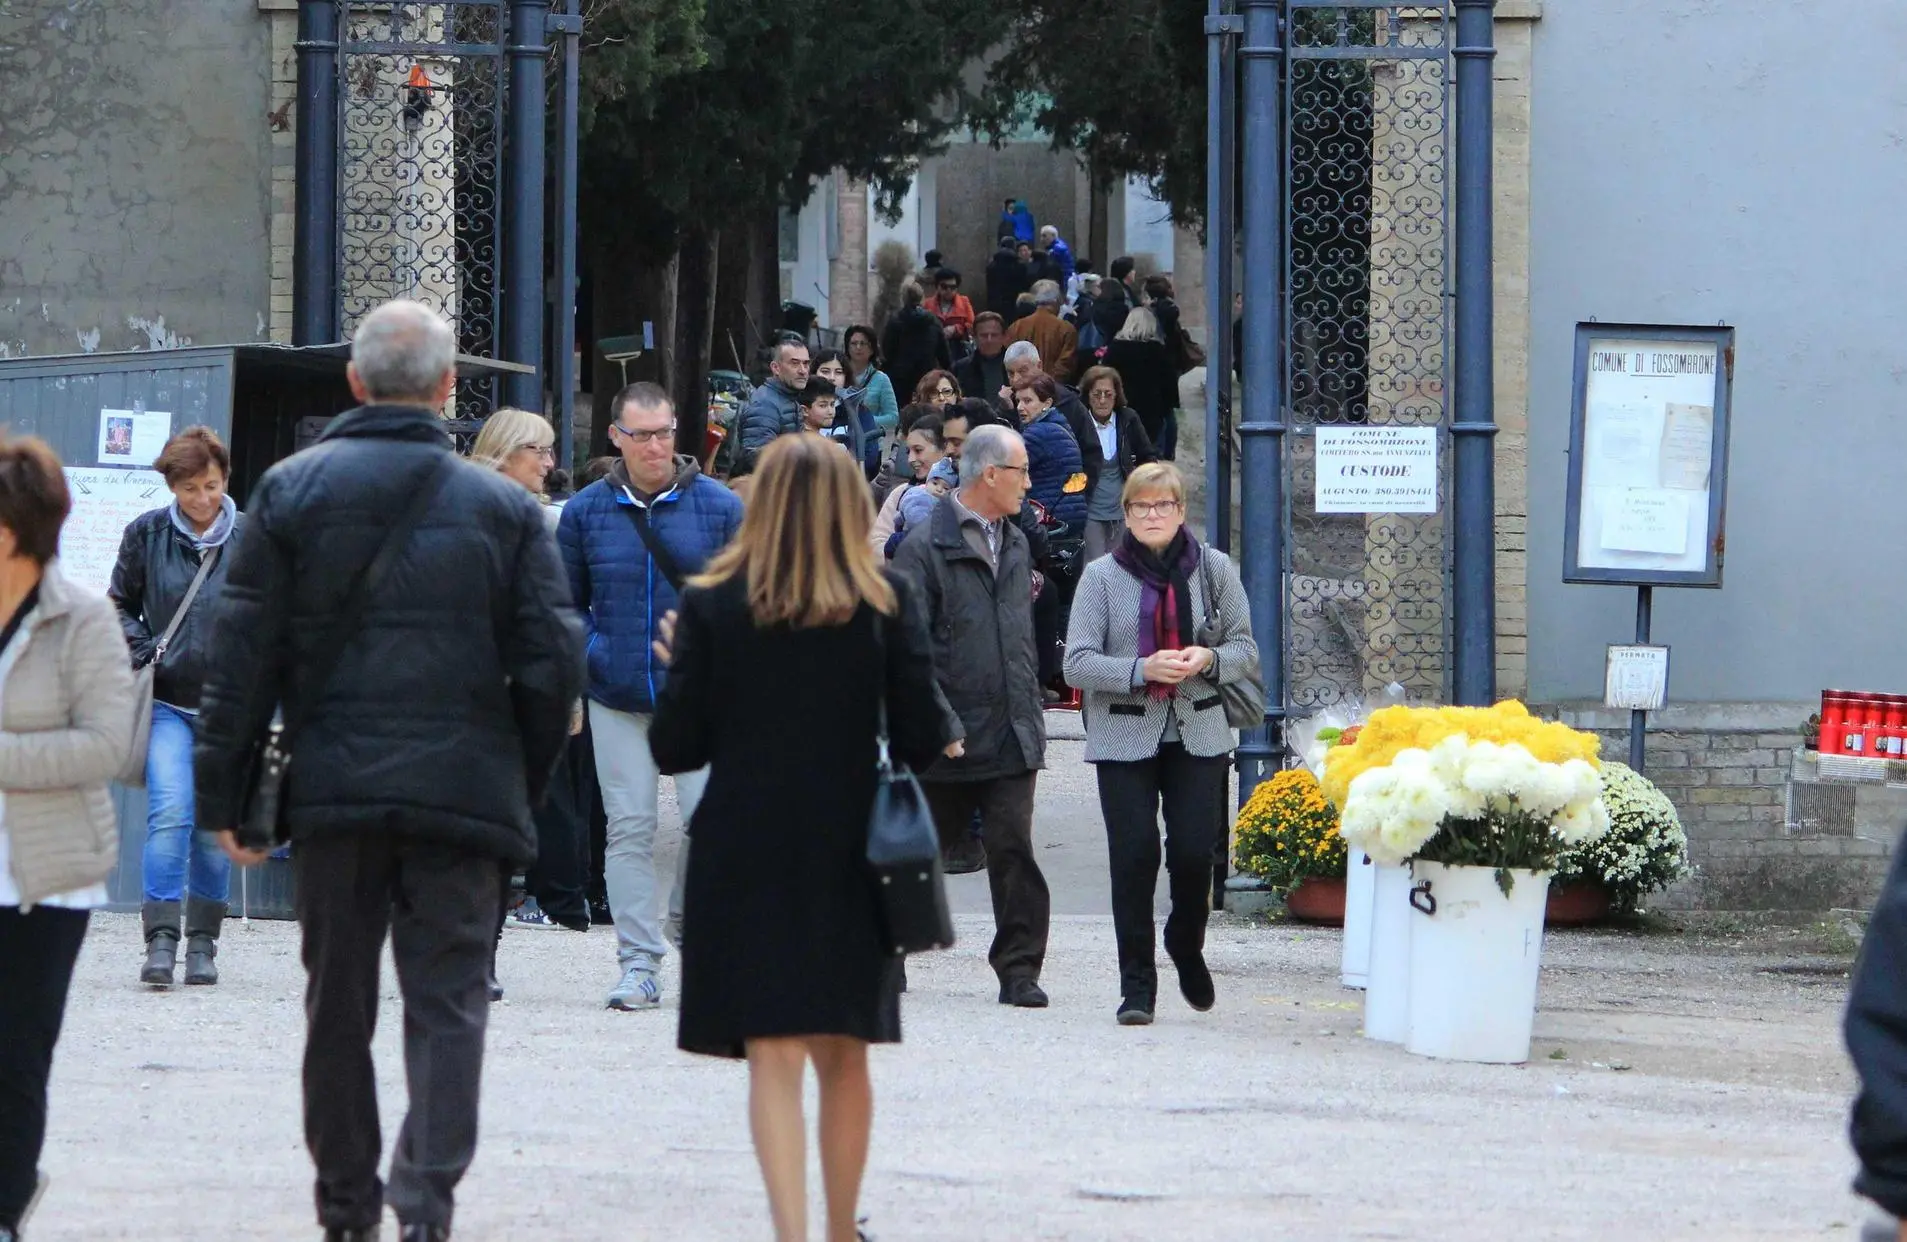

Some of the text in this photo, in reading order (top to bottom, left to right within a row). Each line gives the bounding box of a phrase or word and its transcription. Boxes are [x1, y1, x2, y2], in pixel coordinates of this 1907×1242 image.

[1592, 352, 1715, 375] COMUNE DI FOSSOMBRONE
[1340, 464, 1412, 477] CUSTODE
